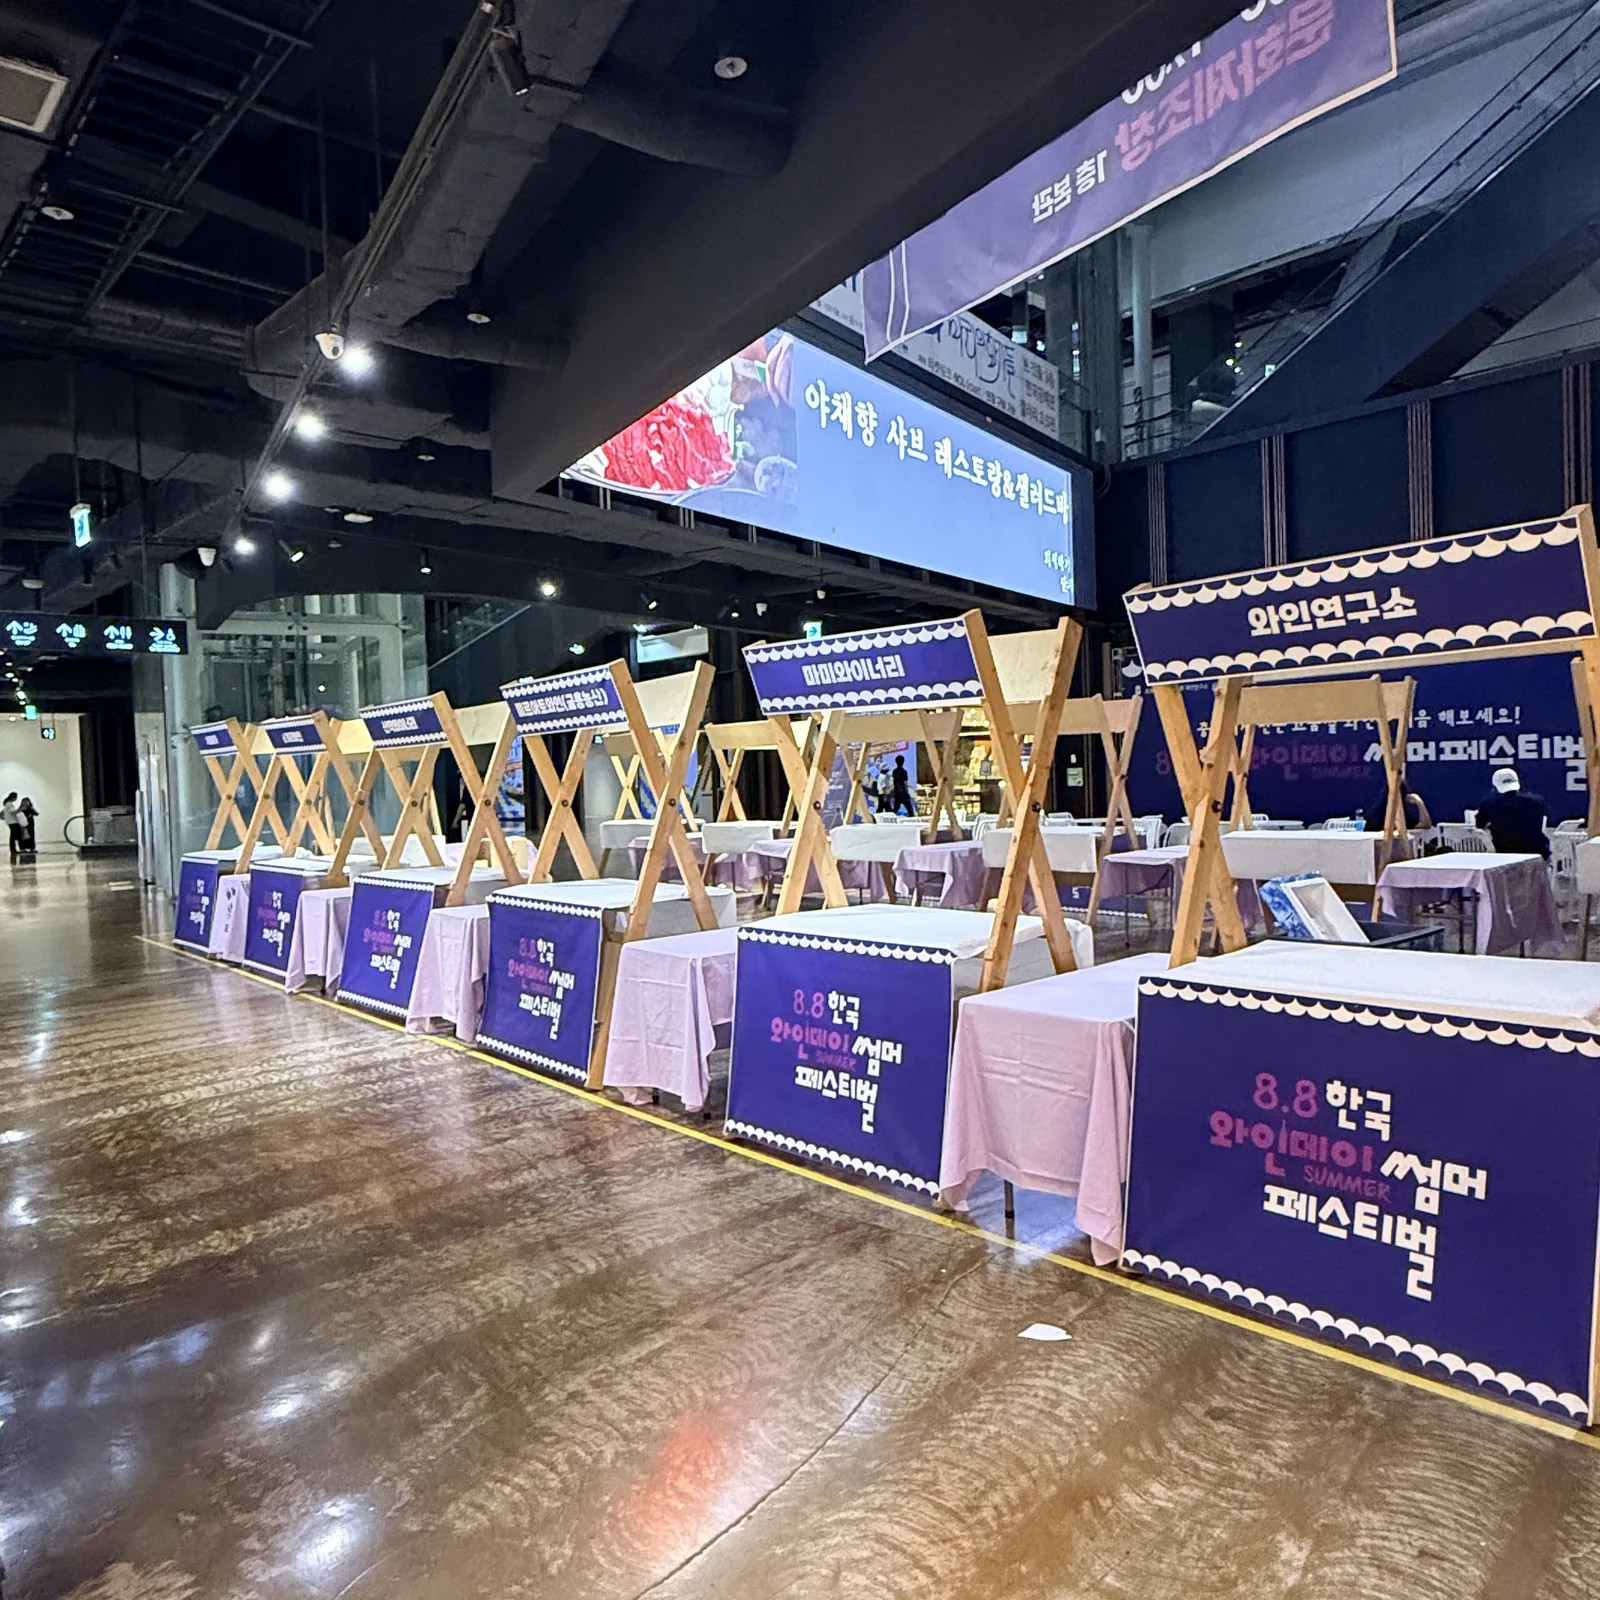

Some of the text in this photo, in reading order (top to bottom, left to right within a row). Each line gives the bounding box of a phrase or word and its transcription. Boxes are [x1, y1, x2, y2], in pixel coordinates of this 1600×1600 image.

[804, 379, 878, 447] 야채향
[886, 415, 928, 461] 샤브
[1247, 587, 1418, 637] 와인연구소
[802, 654, 905, 687] 마미와이너리
[1438, 706, 1521, 727] 해보세요!
[793, 989, 860, 1031] 8.8 한국
[771, 1017, 902, 1076] 와인데이 썸머
[795, 1065, 878, 1134] 페스티벌
[1253, 1072, 1391, 1141] 8.8 한국
[1209, 1110, 1487, 1215] 와인데이 썸머
[1304, 1165, 1391, 1203] SUMMER
[1263, 1184, 1437, 1301] 페스티벌
